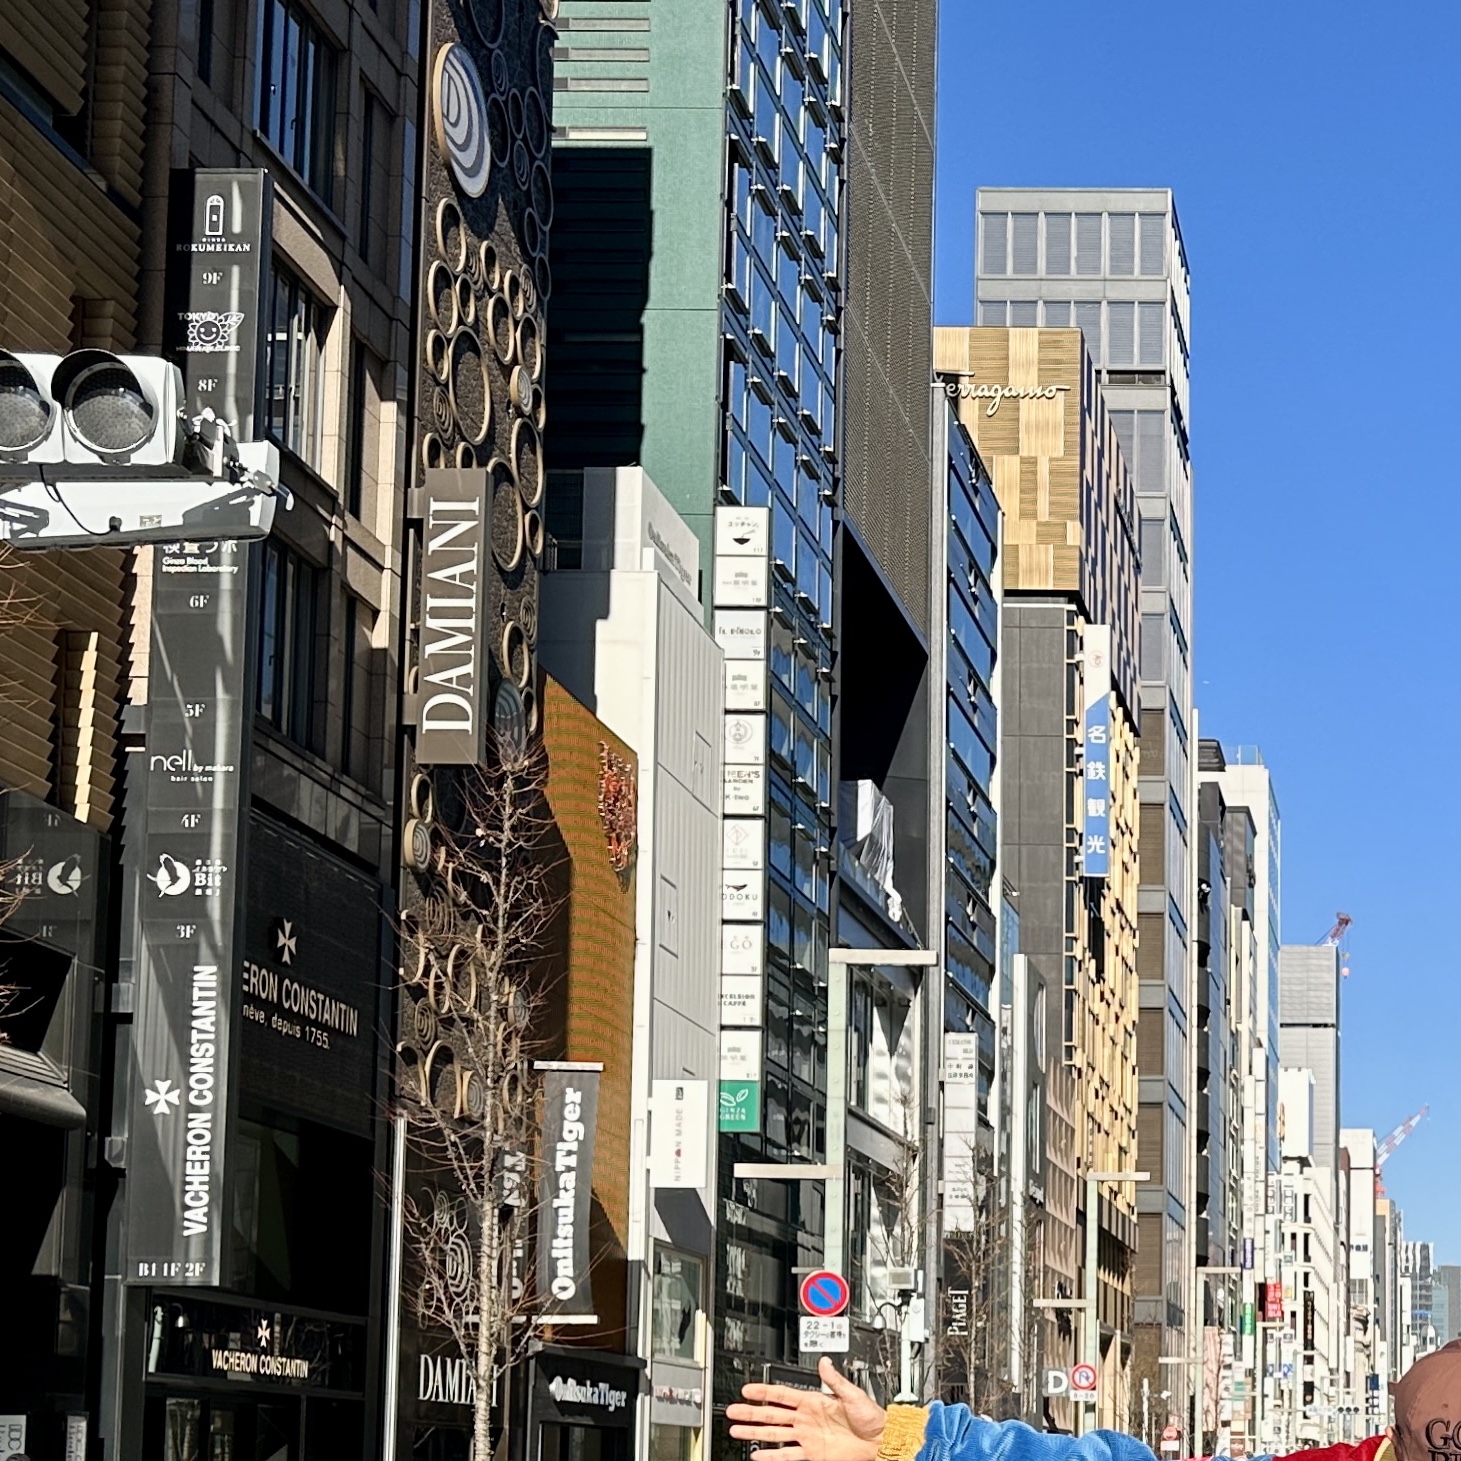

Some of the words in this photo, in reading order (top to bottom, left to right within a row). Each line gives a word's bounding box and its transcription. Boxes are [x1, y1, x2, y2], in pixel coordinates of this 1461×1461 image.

[176, 243, 251, 252] ROKUMEIKAN
[202, 272, 223, 285] 9F
[198, 378, 218, 392] 8F
[189, 595, 209, 608] 6F
[422, 496, 480, 735] DAMIANI
[184, 704, 206, 718] 5F
[150, 749, 193, 772] nell
[1086, 725, 1106, 854] 名鉄観光
[181, 814, 202, 828] 4F
[194, 872, 222, 887] Bit
[176, 924, 197, 938] 3F
[282, 978, 358, 1037] CONSTANTIN
[188, 965, 218, 1106] CONSTANTIN
[271, 1014, 301, 1042] depuis
[305, 1019, 331, 1050] 1755.
[675, 1108, 683, 1137] MADE
[183, 1112, 212, 1237] VACHERON
[552, 1087, 585, 1300] OnitsukaTiger
[138, 1262, 157, 1277] B1
[162, 1262, 181, 1277] 1F
[184, 1262, 206, 1277] 2F
[947, 1286, 969, 1336] PIAGET
[212, 1349, 259, 1374] VACHERON
[260, 1354, 310, 1378] CONSTANTIN
[550, 1375, 627, 1412] OnitsukaTiger
[1047, 1370, 1068, 1394] D
